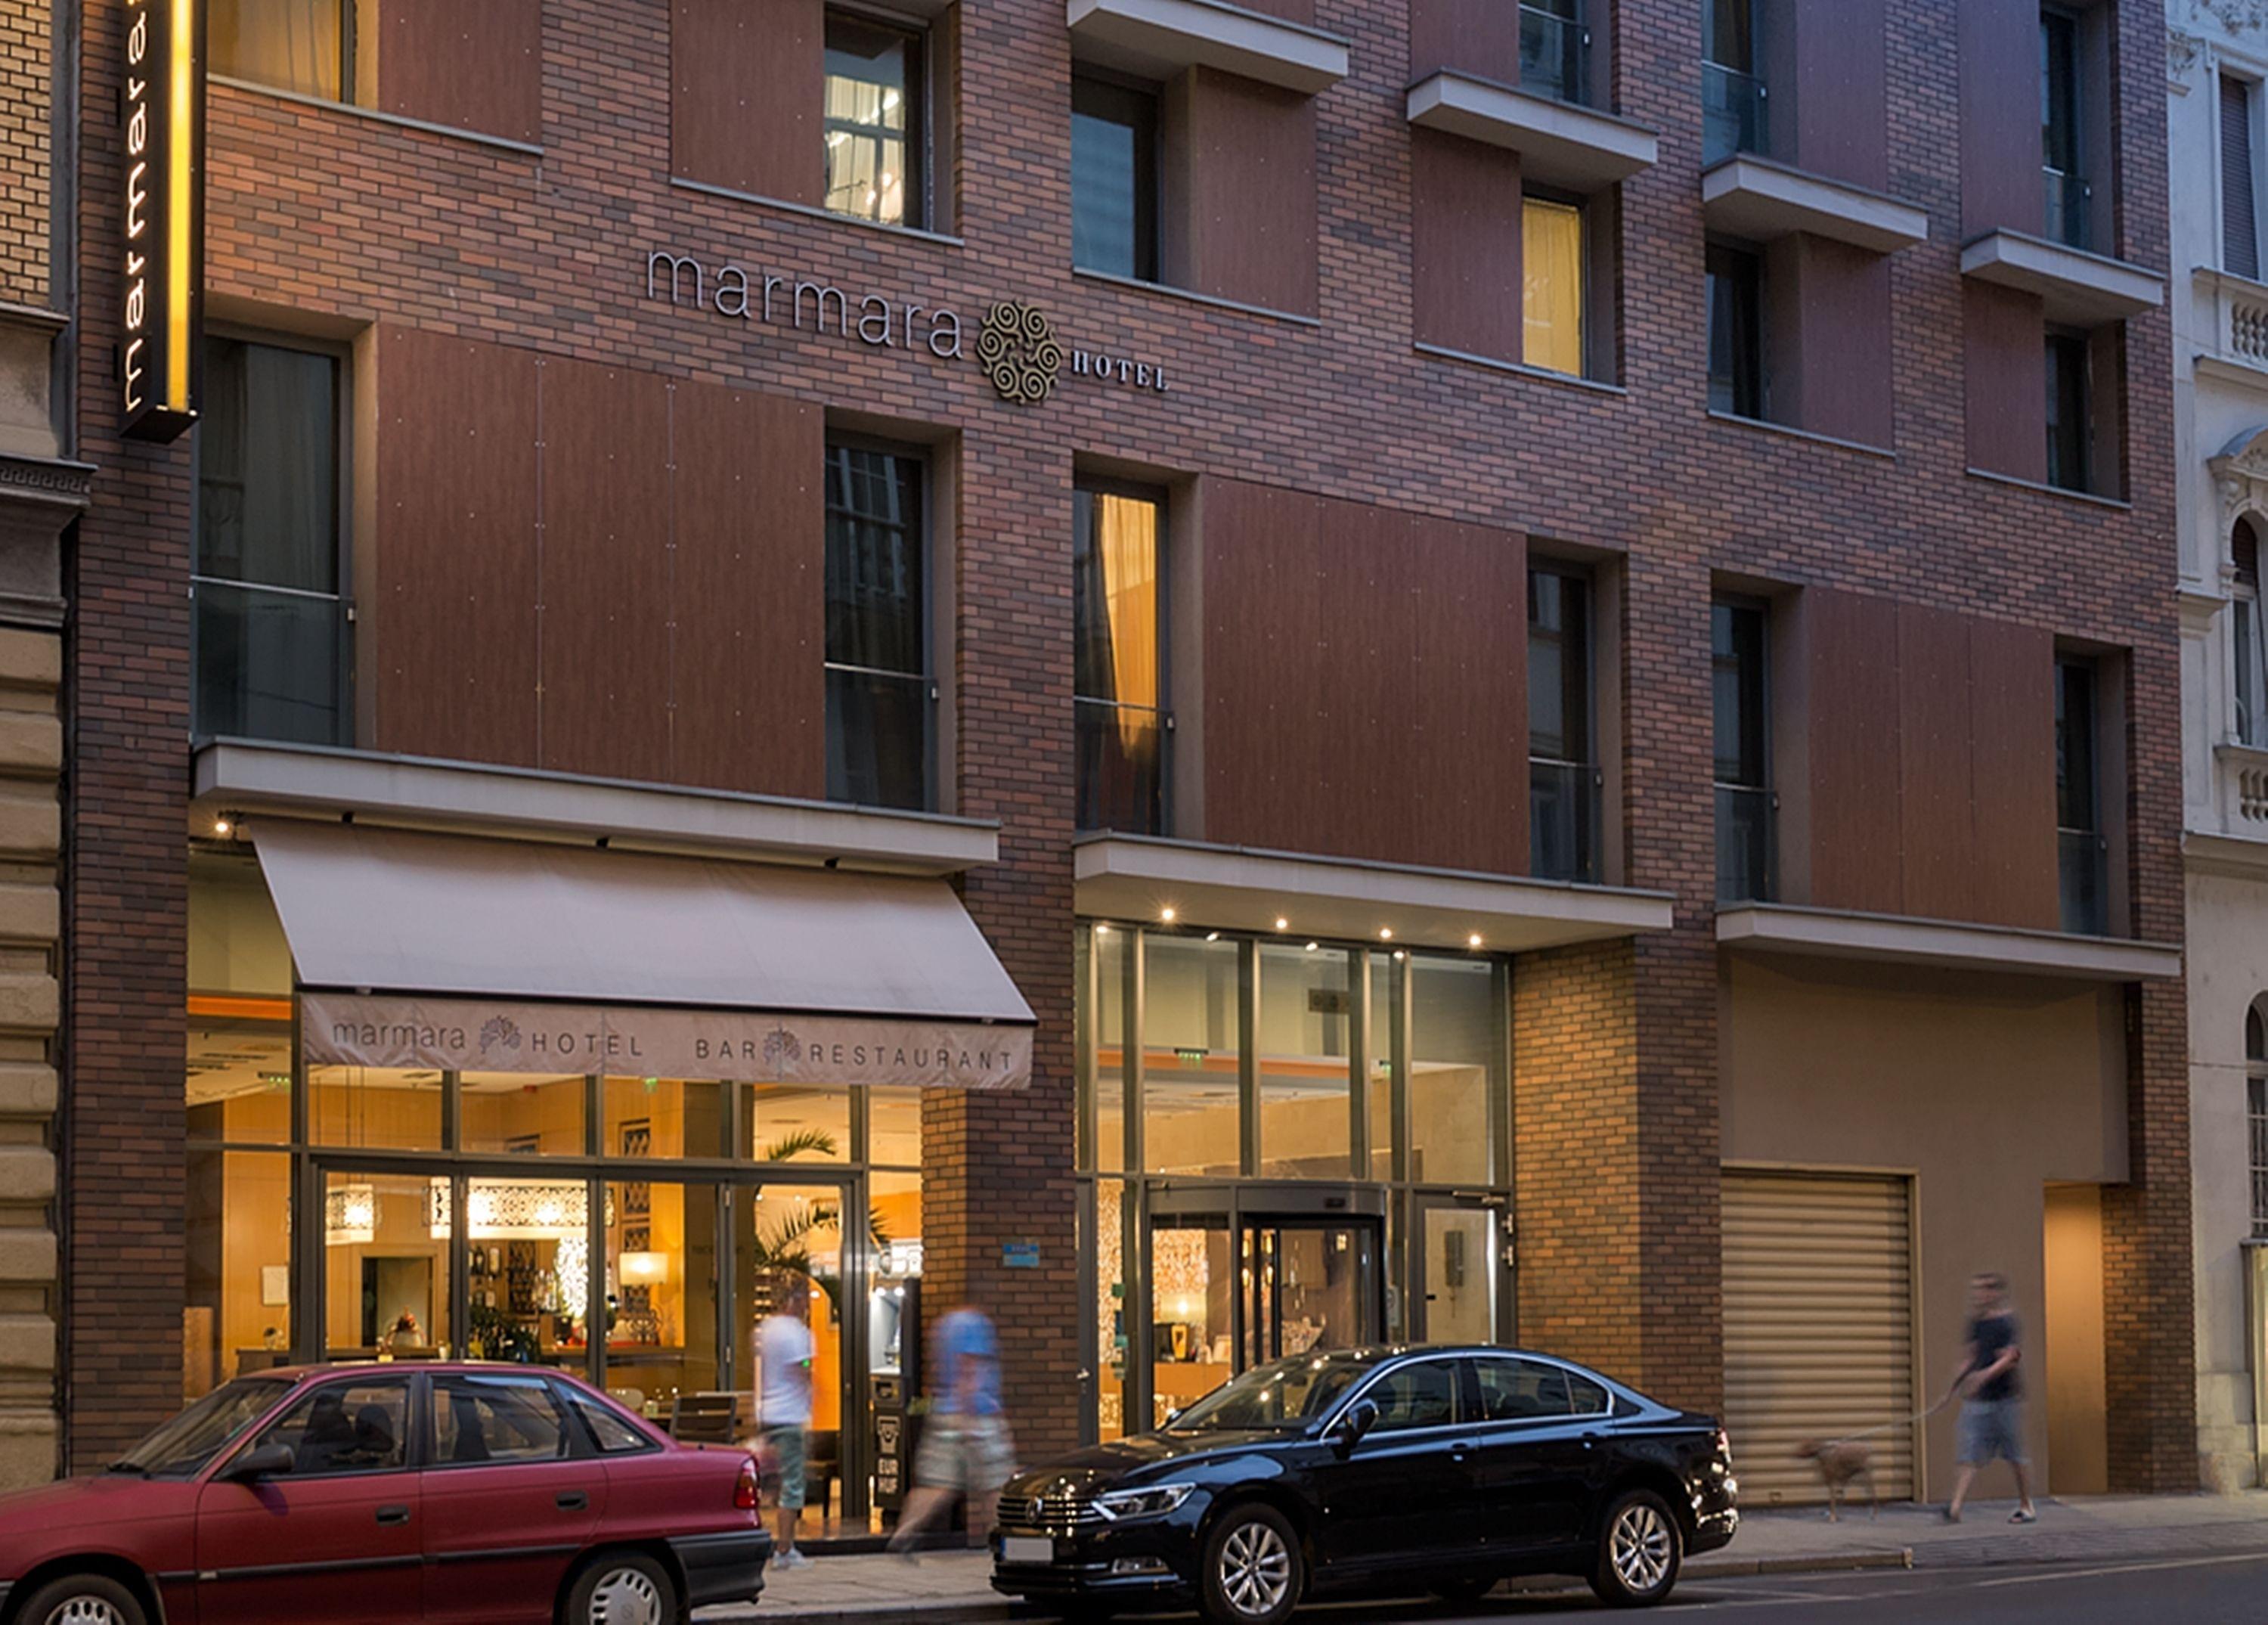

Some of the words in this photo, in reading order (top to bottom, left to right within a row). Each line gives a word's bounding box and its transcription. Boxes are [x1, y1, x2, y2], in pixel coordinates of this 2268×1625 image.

[125, 11, 147, 412] marmara
[646, 250, 963, 360] marmara
[1070, 349, 1170, 393] HOTEL
[333, 1022, 466, 1050] marmara
[531, 1033, 643, 1056] HOTEL
[696, 1039, 755, 1060] BAR
[810, 1044, 1012, 1071] RESTAURANT
